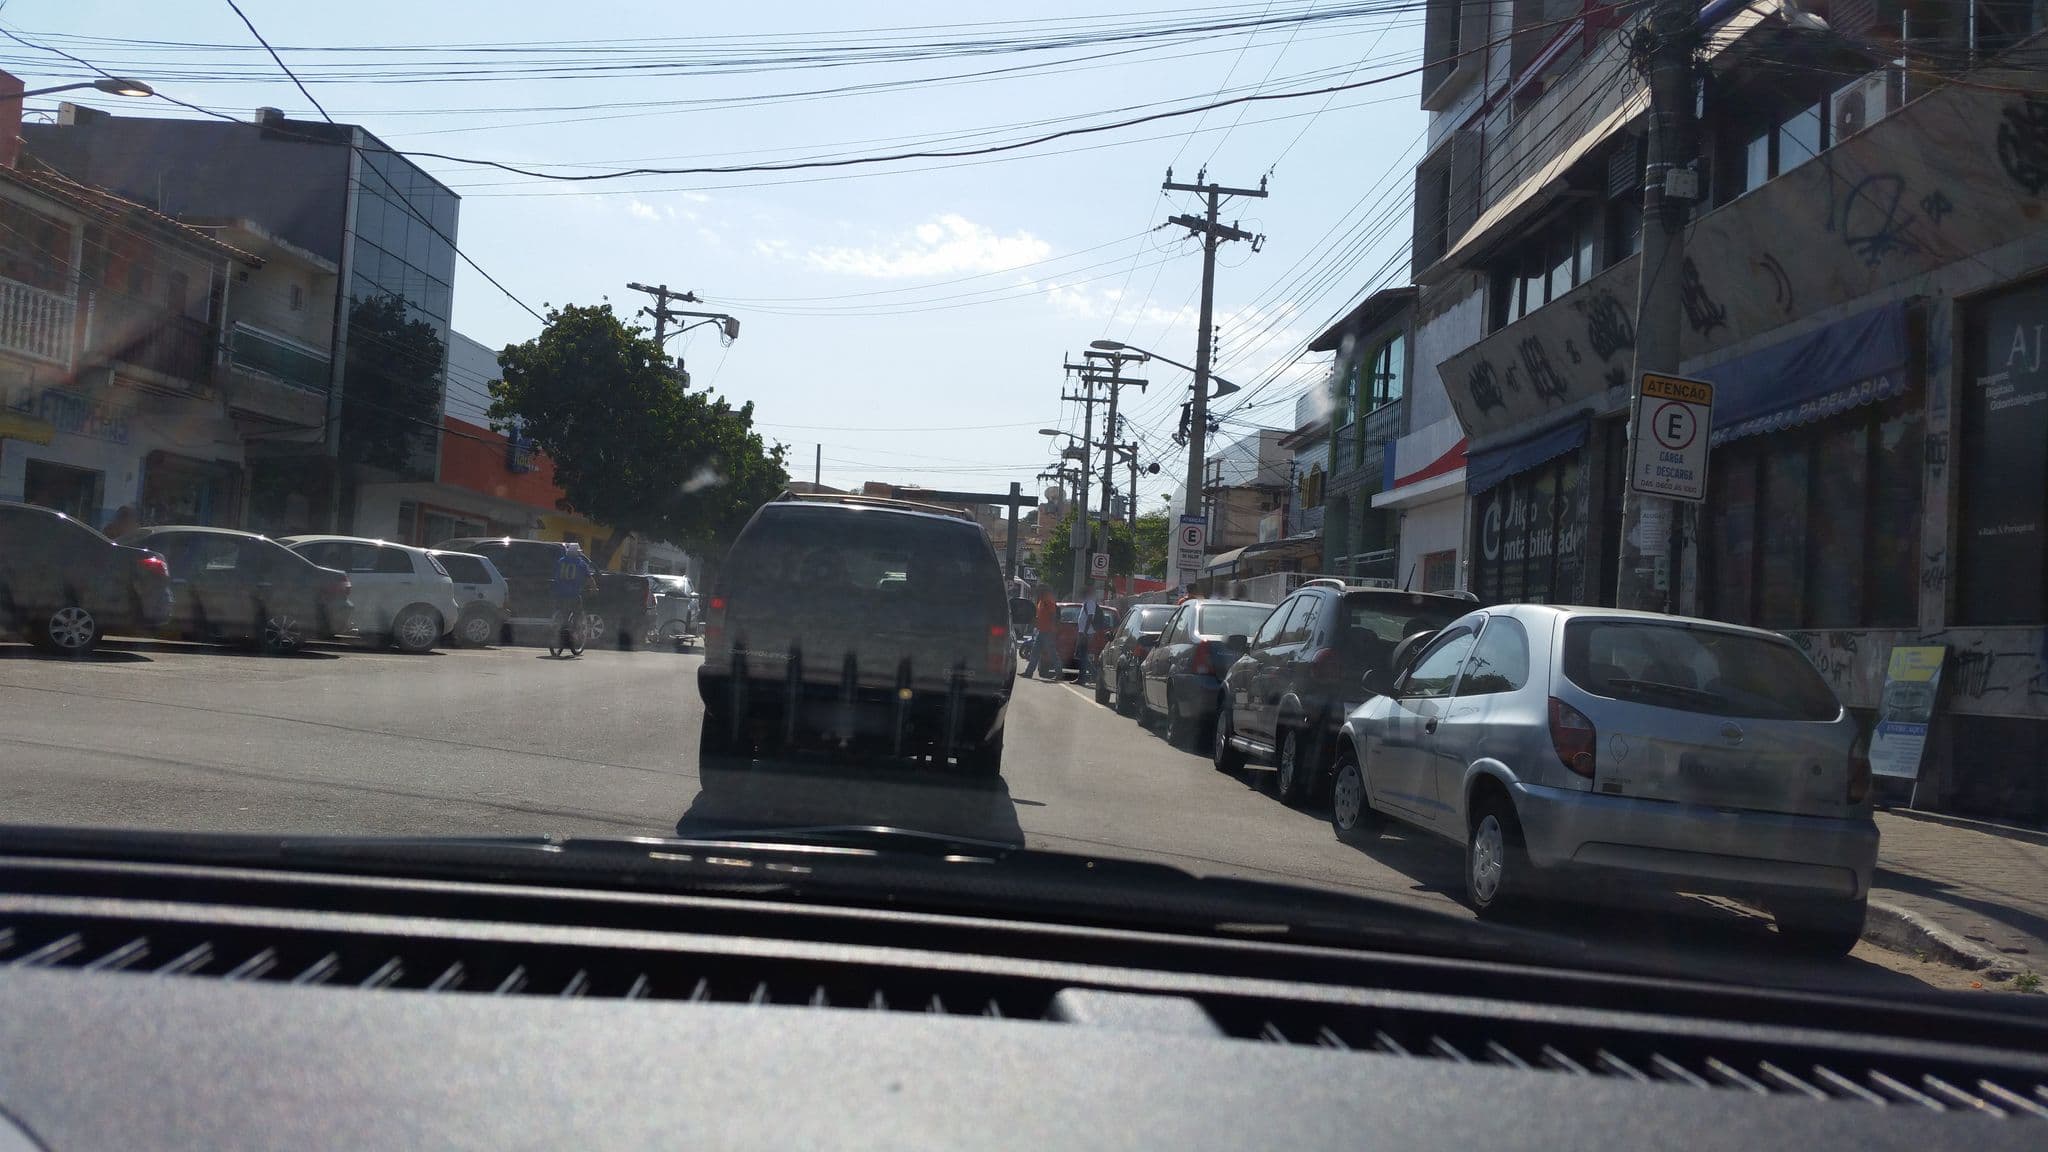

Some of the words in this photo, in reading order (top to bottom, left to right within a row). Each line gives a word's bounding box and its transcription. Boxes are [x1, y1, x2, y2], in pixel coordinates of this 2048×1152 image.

[1798, 376, 1891, 415] PAPELARIA
[1667, 413, 1682, 440] E
[1659, 451, 1685, 465] CARGA
[1645, 464, 1652, 474] E
[1656, 465, 1694, 481] DESCARGA
[1188, 530, 1197, 543] E
[1097, 557, 1104, 566] E
[560, 562, 577, 581] 10
